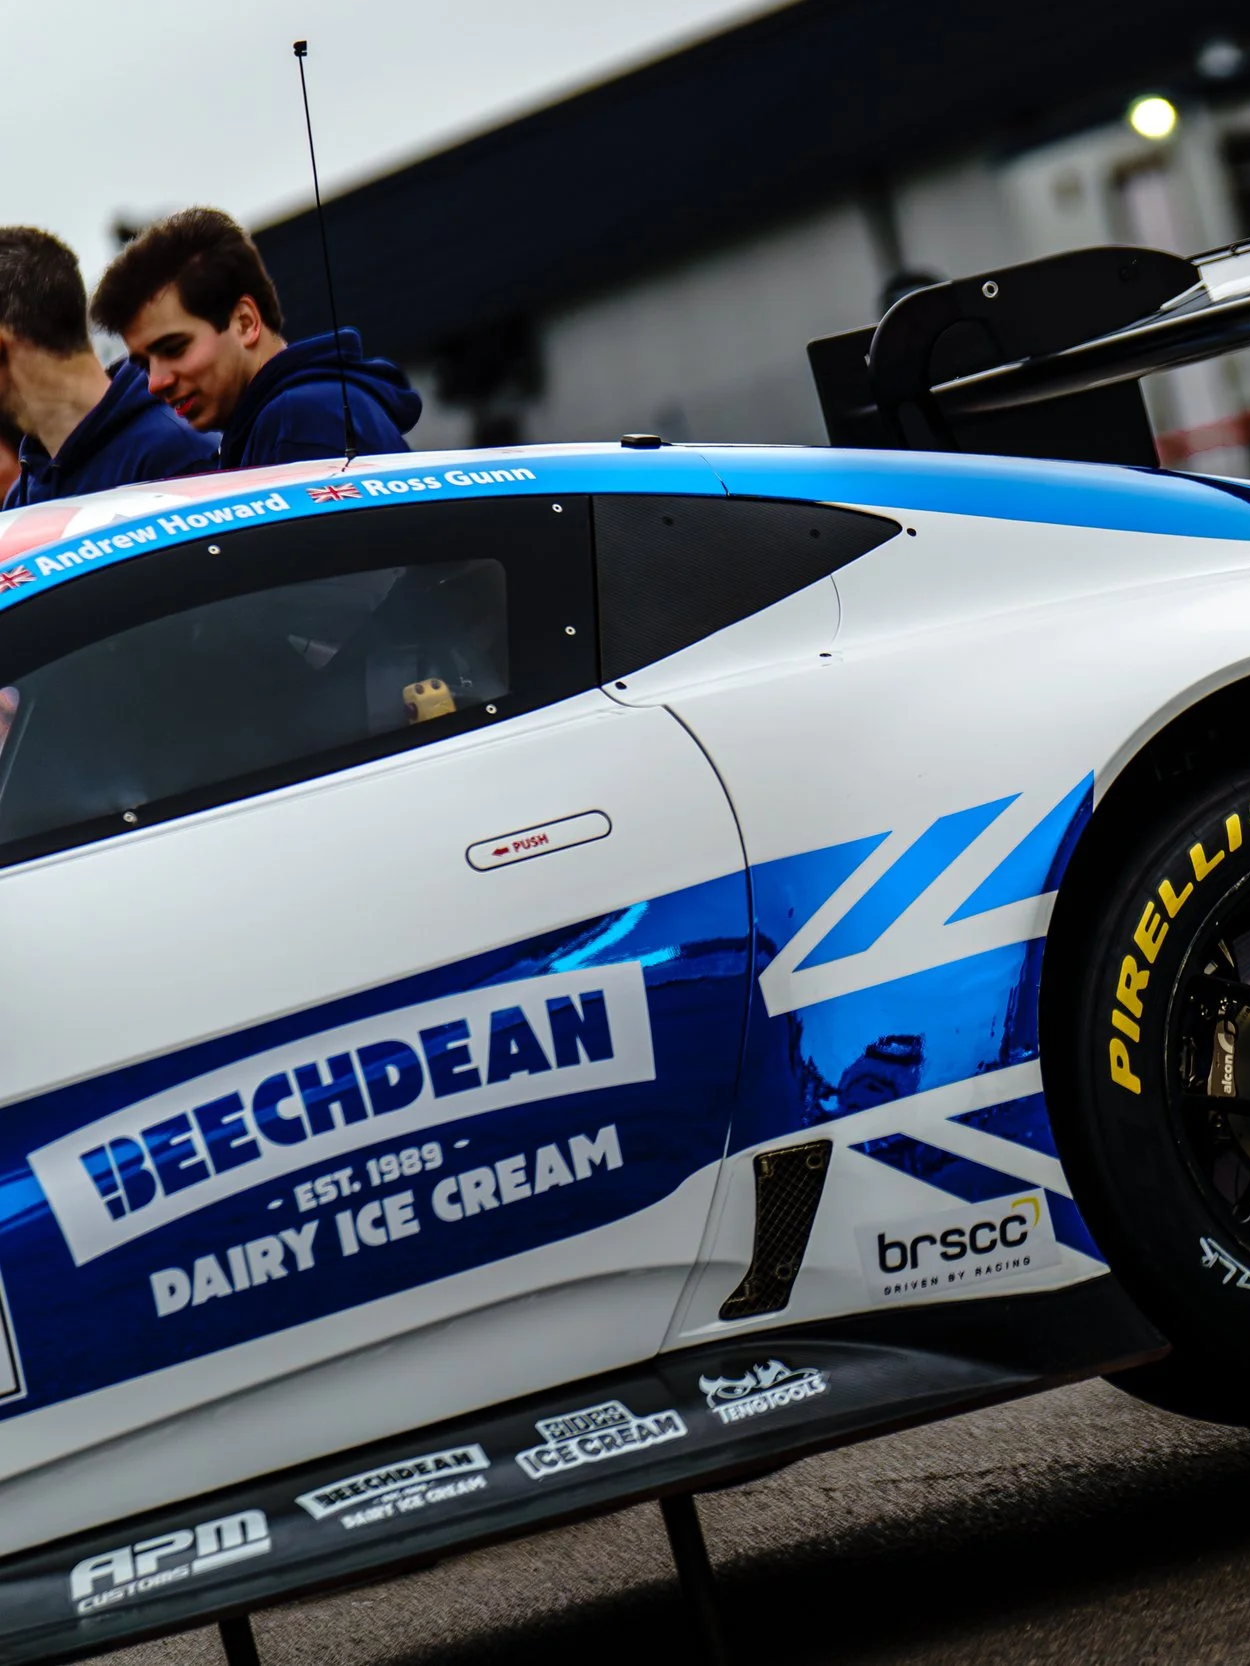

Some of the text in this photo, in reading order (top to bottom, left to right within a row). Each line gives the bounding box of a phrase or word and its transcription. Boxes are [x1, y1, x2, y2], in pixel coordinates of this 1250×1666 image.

[361, 468, 537, 497] Ross Gunn
[35, 493, 291, 577] Andrew Howard
[512, 833, 549, 852] PUSH
[1109, 813, 1241, 1095] PIRELLI
[1221, 1054, 1234, 1094] alcon
[79, 988, 615, 1222] BEECHDEAN
[293, 1141, 443, 1211] EST. 1989
[149, 1123, 624, 1317] DAIRY ICE CREAM
[877, 1213, 1028, 1274] brscc
[884, 1255, 1031, 1295] DRIVEN BY RACING
[523, 1415, 681, 1473] ICE CREAM
[313, 1450, 475, 1508] BEECHDEAN
[77, 1564, 190, 1615] CUSTOMS
